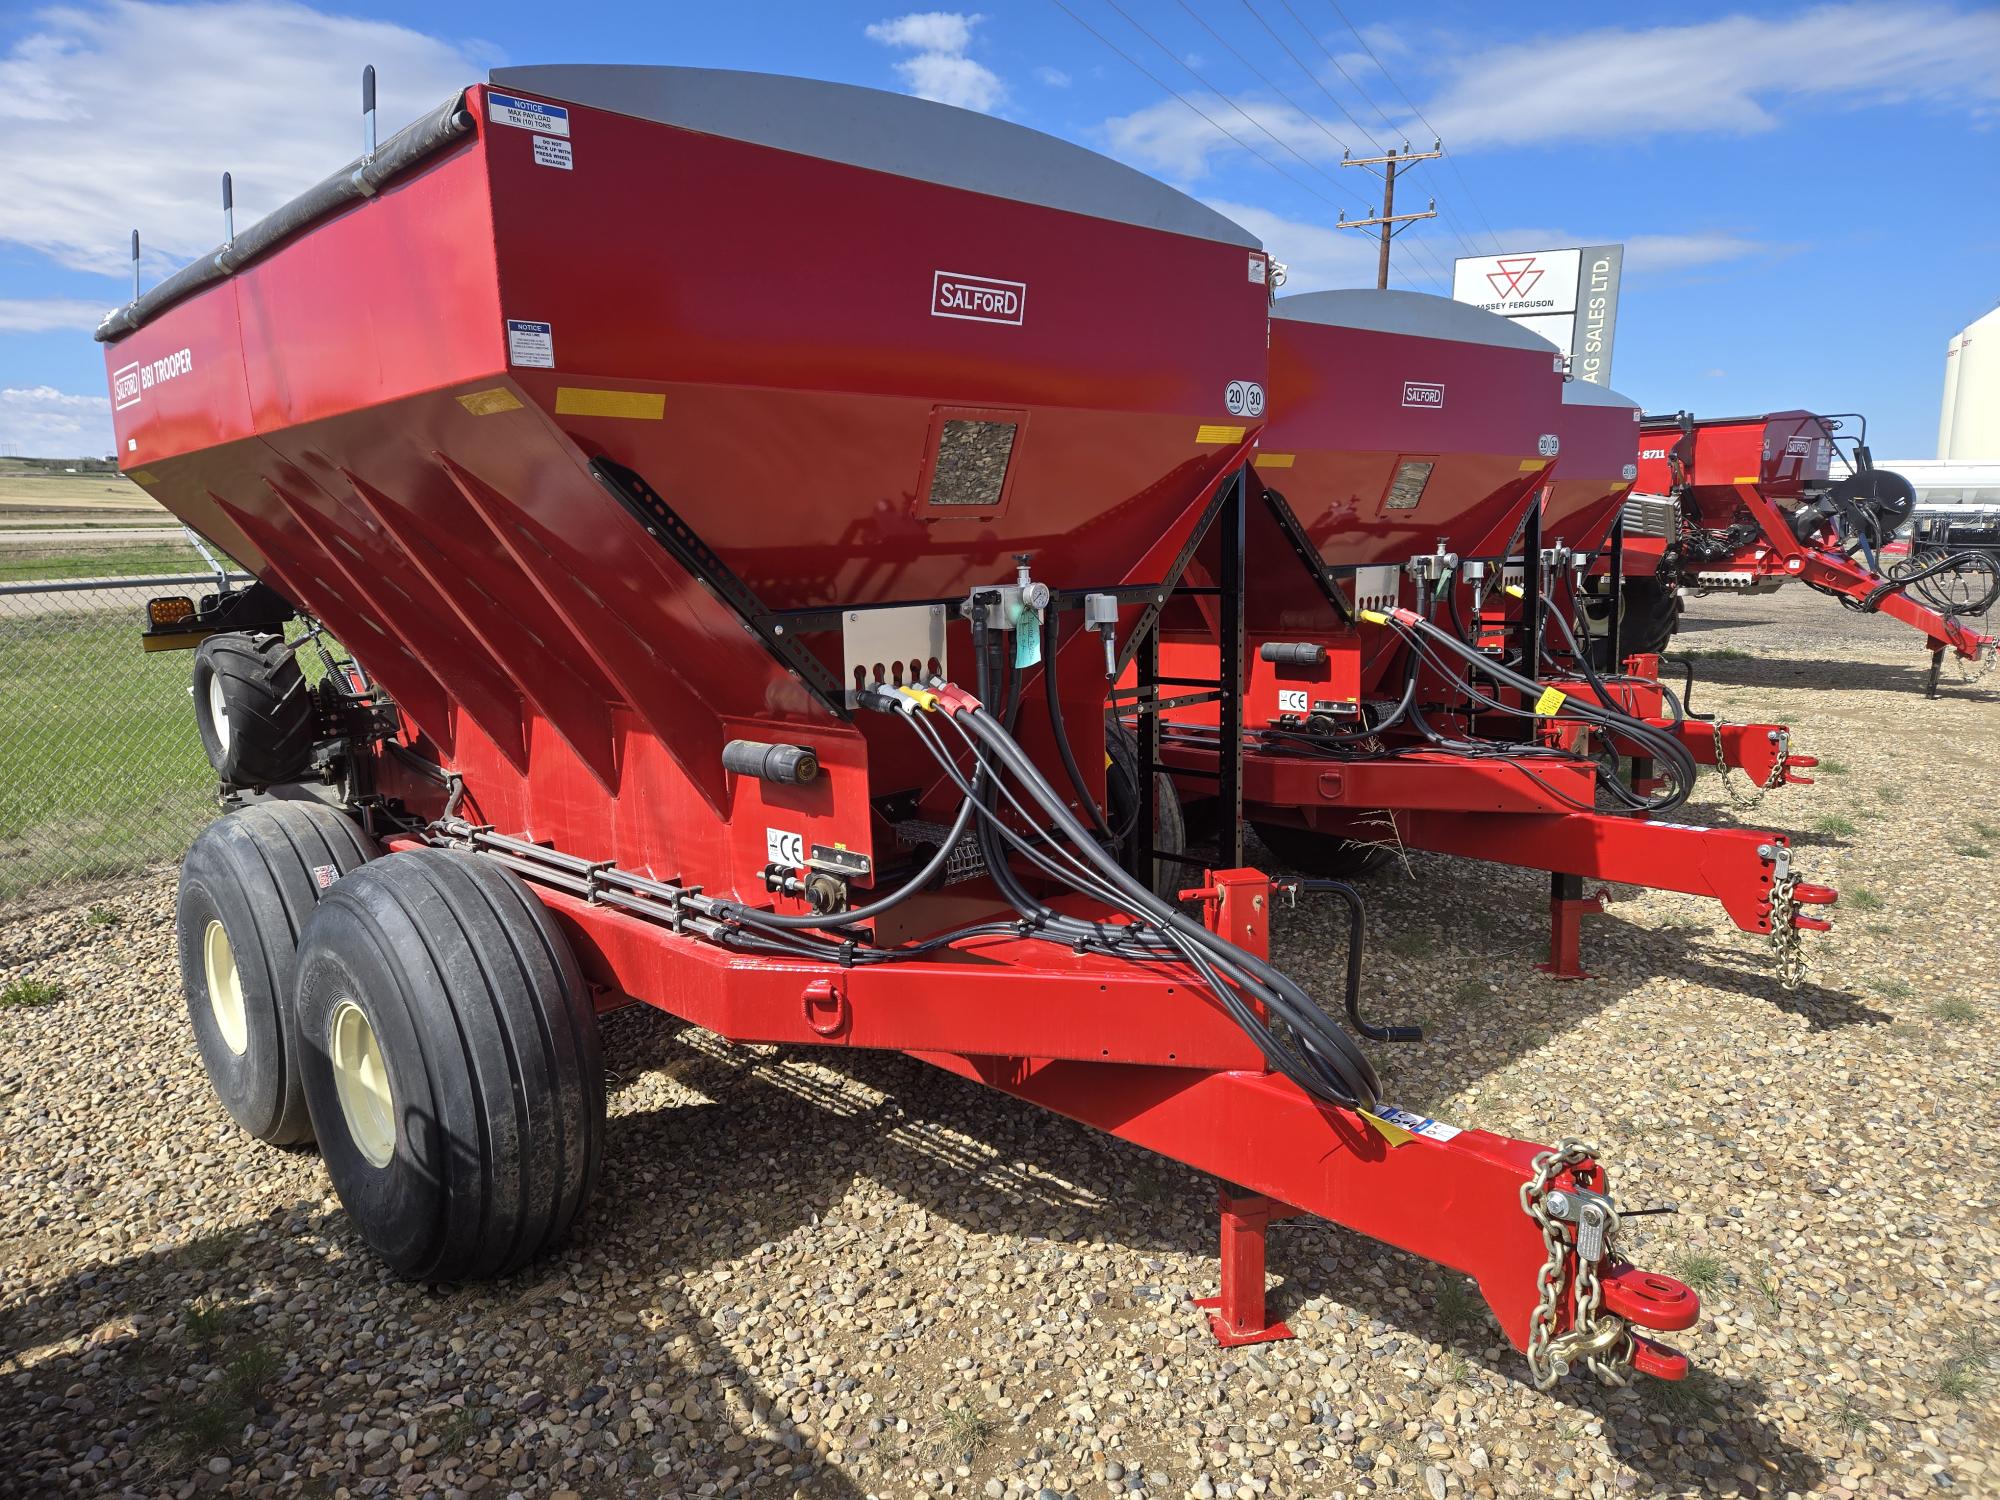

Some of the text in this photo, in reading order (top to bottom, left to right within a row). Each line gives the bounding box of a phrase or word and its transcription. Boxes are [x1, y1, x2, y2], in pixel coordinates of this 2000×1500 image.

[514, 100, 543, 113] NOTICE
[508, 108, 551, 122] MAX PAYLOAD
[509, 115, 552, 129] TEN (10) TONS
[535, 143, 548, 151] BACK
[536, 150, 571, 161] PRESS WHEEL
[941, 282, 1018, 315] SALFORD
[1474, 299, 1554, 312] ASSEY FERGUSON
[1582, 256, 1610, 384] AG SALES LTD.
[518, 324, 542, 332] NOTICE
[115, 348, 193, 401] SALFORD BBI TROOPER
[1230, 390, 1260, 406] 20 30
[1406, 387, 1441, 403] SALFORD
[1540, 439, 1547, 449] 20
[1642, 449, 1665, 460] 8711
[1289, 693, 1306, 709] CE
[780, 834, 804, 865] CE
